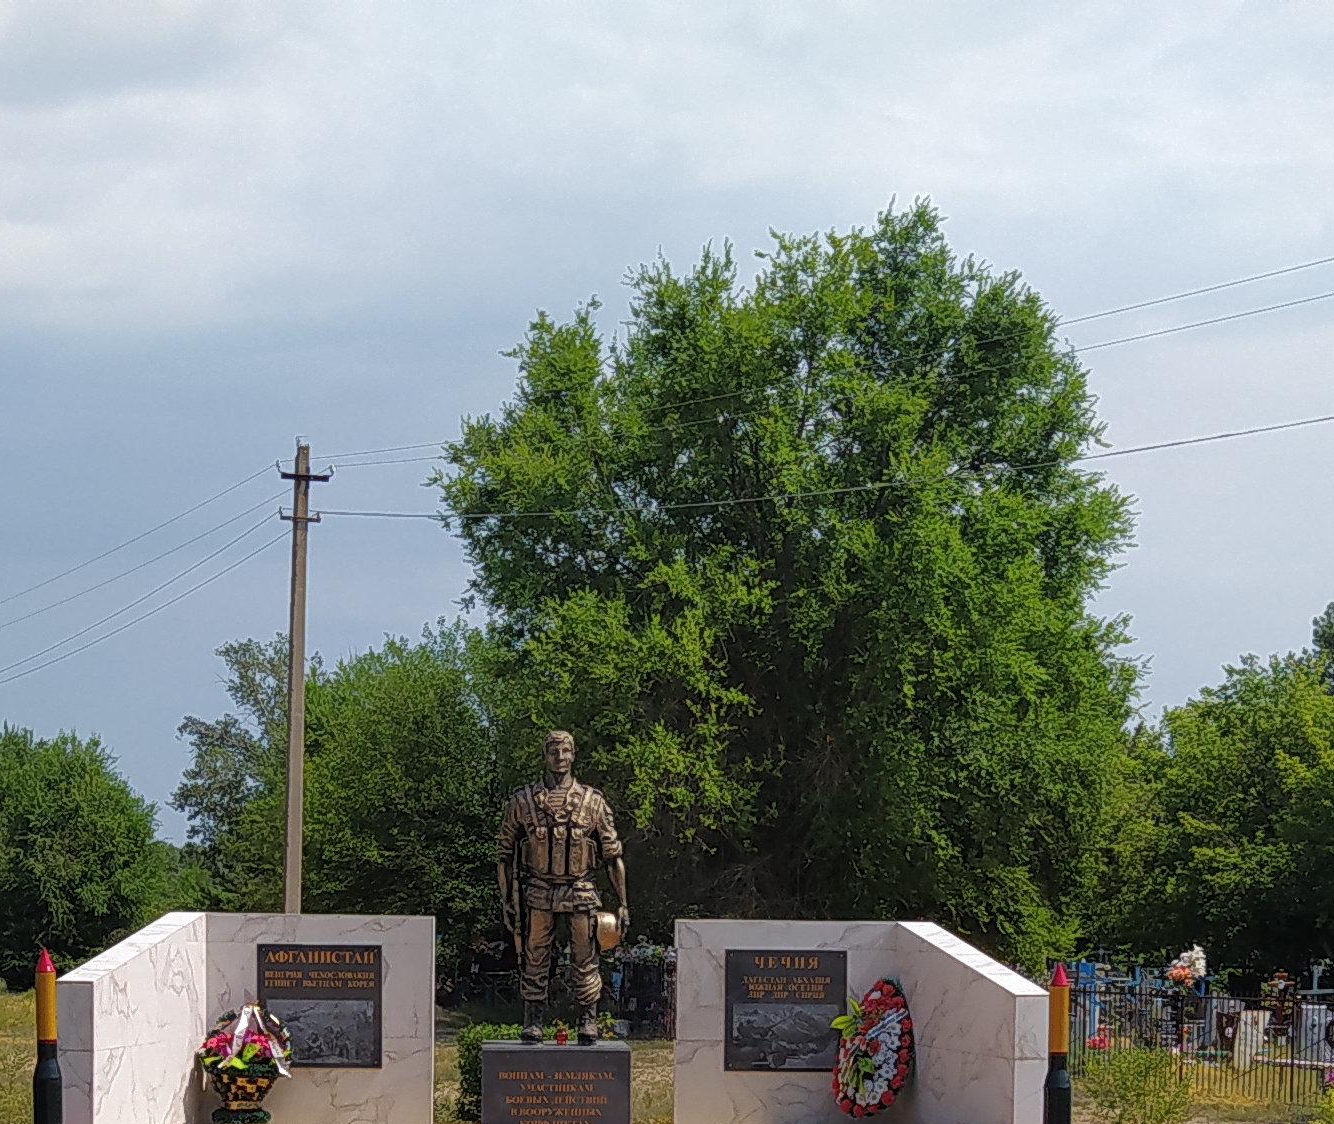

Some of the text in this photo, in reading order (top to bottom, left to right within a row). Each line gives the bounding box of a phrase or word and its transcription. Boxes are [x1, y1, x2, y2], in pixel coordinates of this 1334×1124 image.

[265, 950, 375, 964] АФГАНИСТАН
[754, 956, 819, 969] ЧЕЧНЯ
[498, 1071, 544, 1080] ВОИНАМ
[520, 1083, 594, 1092] УЧАСТНИКАМ
[505, 1095, 549, 1104] БОЕВЫХ
